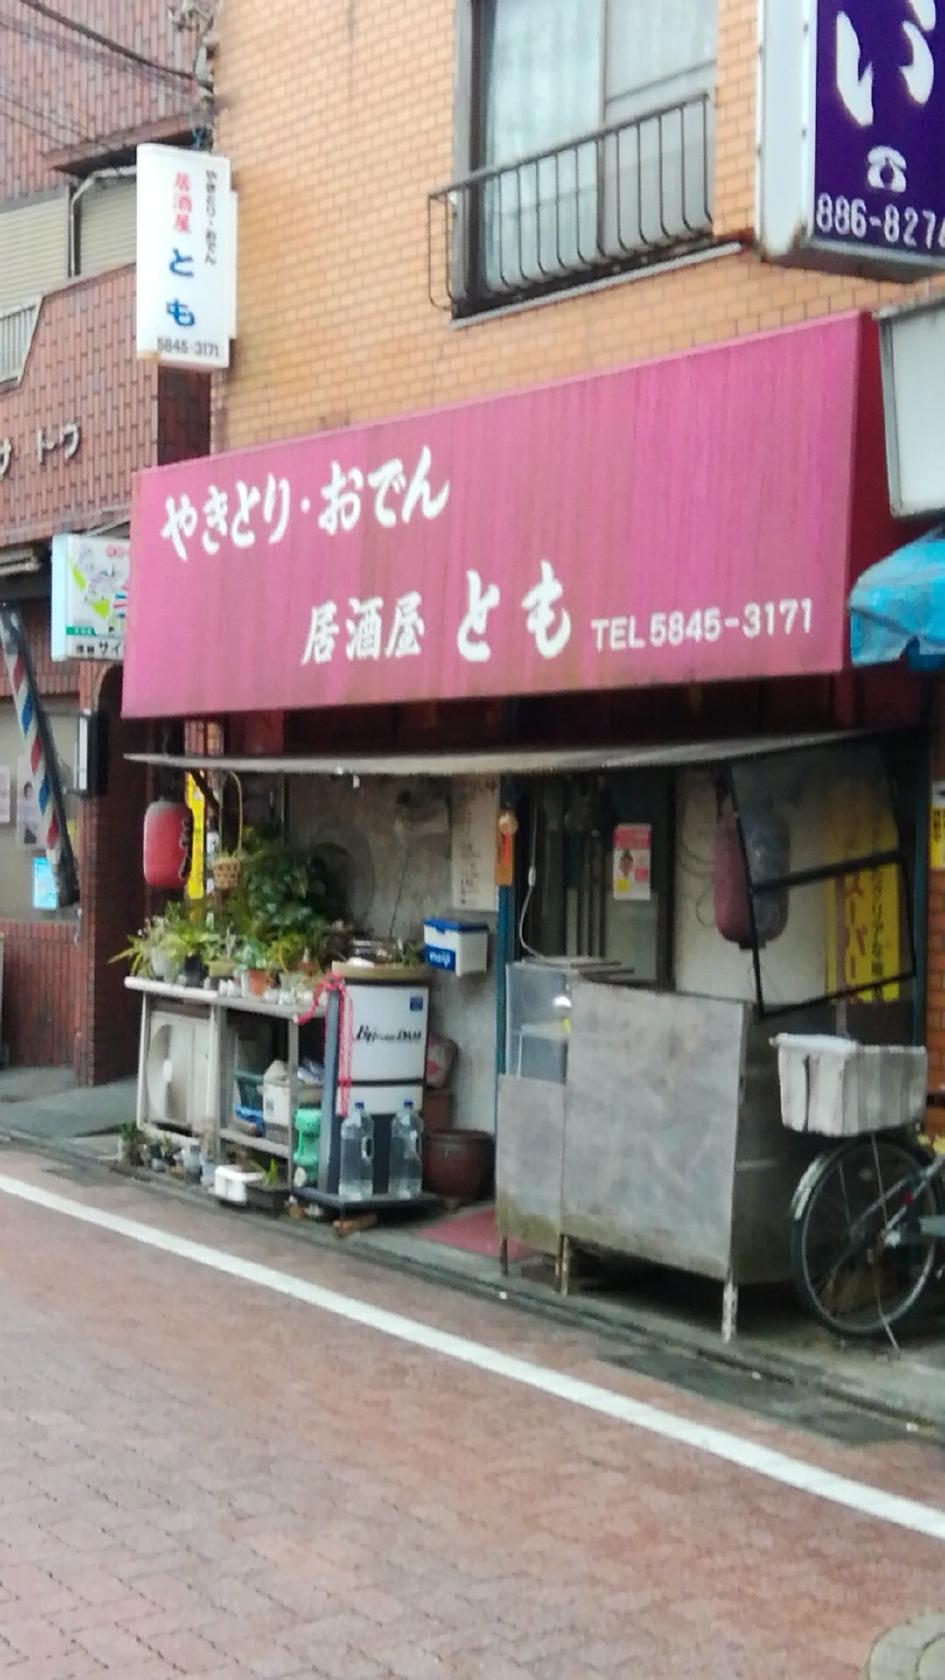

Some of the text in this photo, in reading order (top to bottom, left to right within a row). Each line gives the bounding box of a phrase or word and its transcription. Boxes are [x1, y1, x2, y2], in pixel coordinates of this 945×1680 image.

[165, 247, 195, 327] とも
[160, 445, 450, 561] やきとり・おでん
[301, 560, 812, 665] 居酒屋 とも TEL 5845-3171
